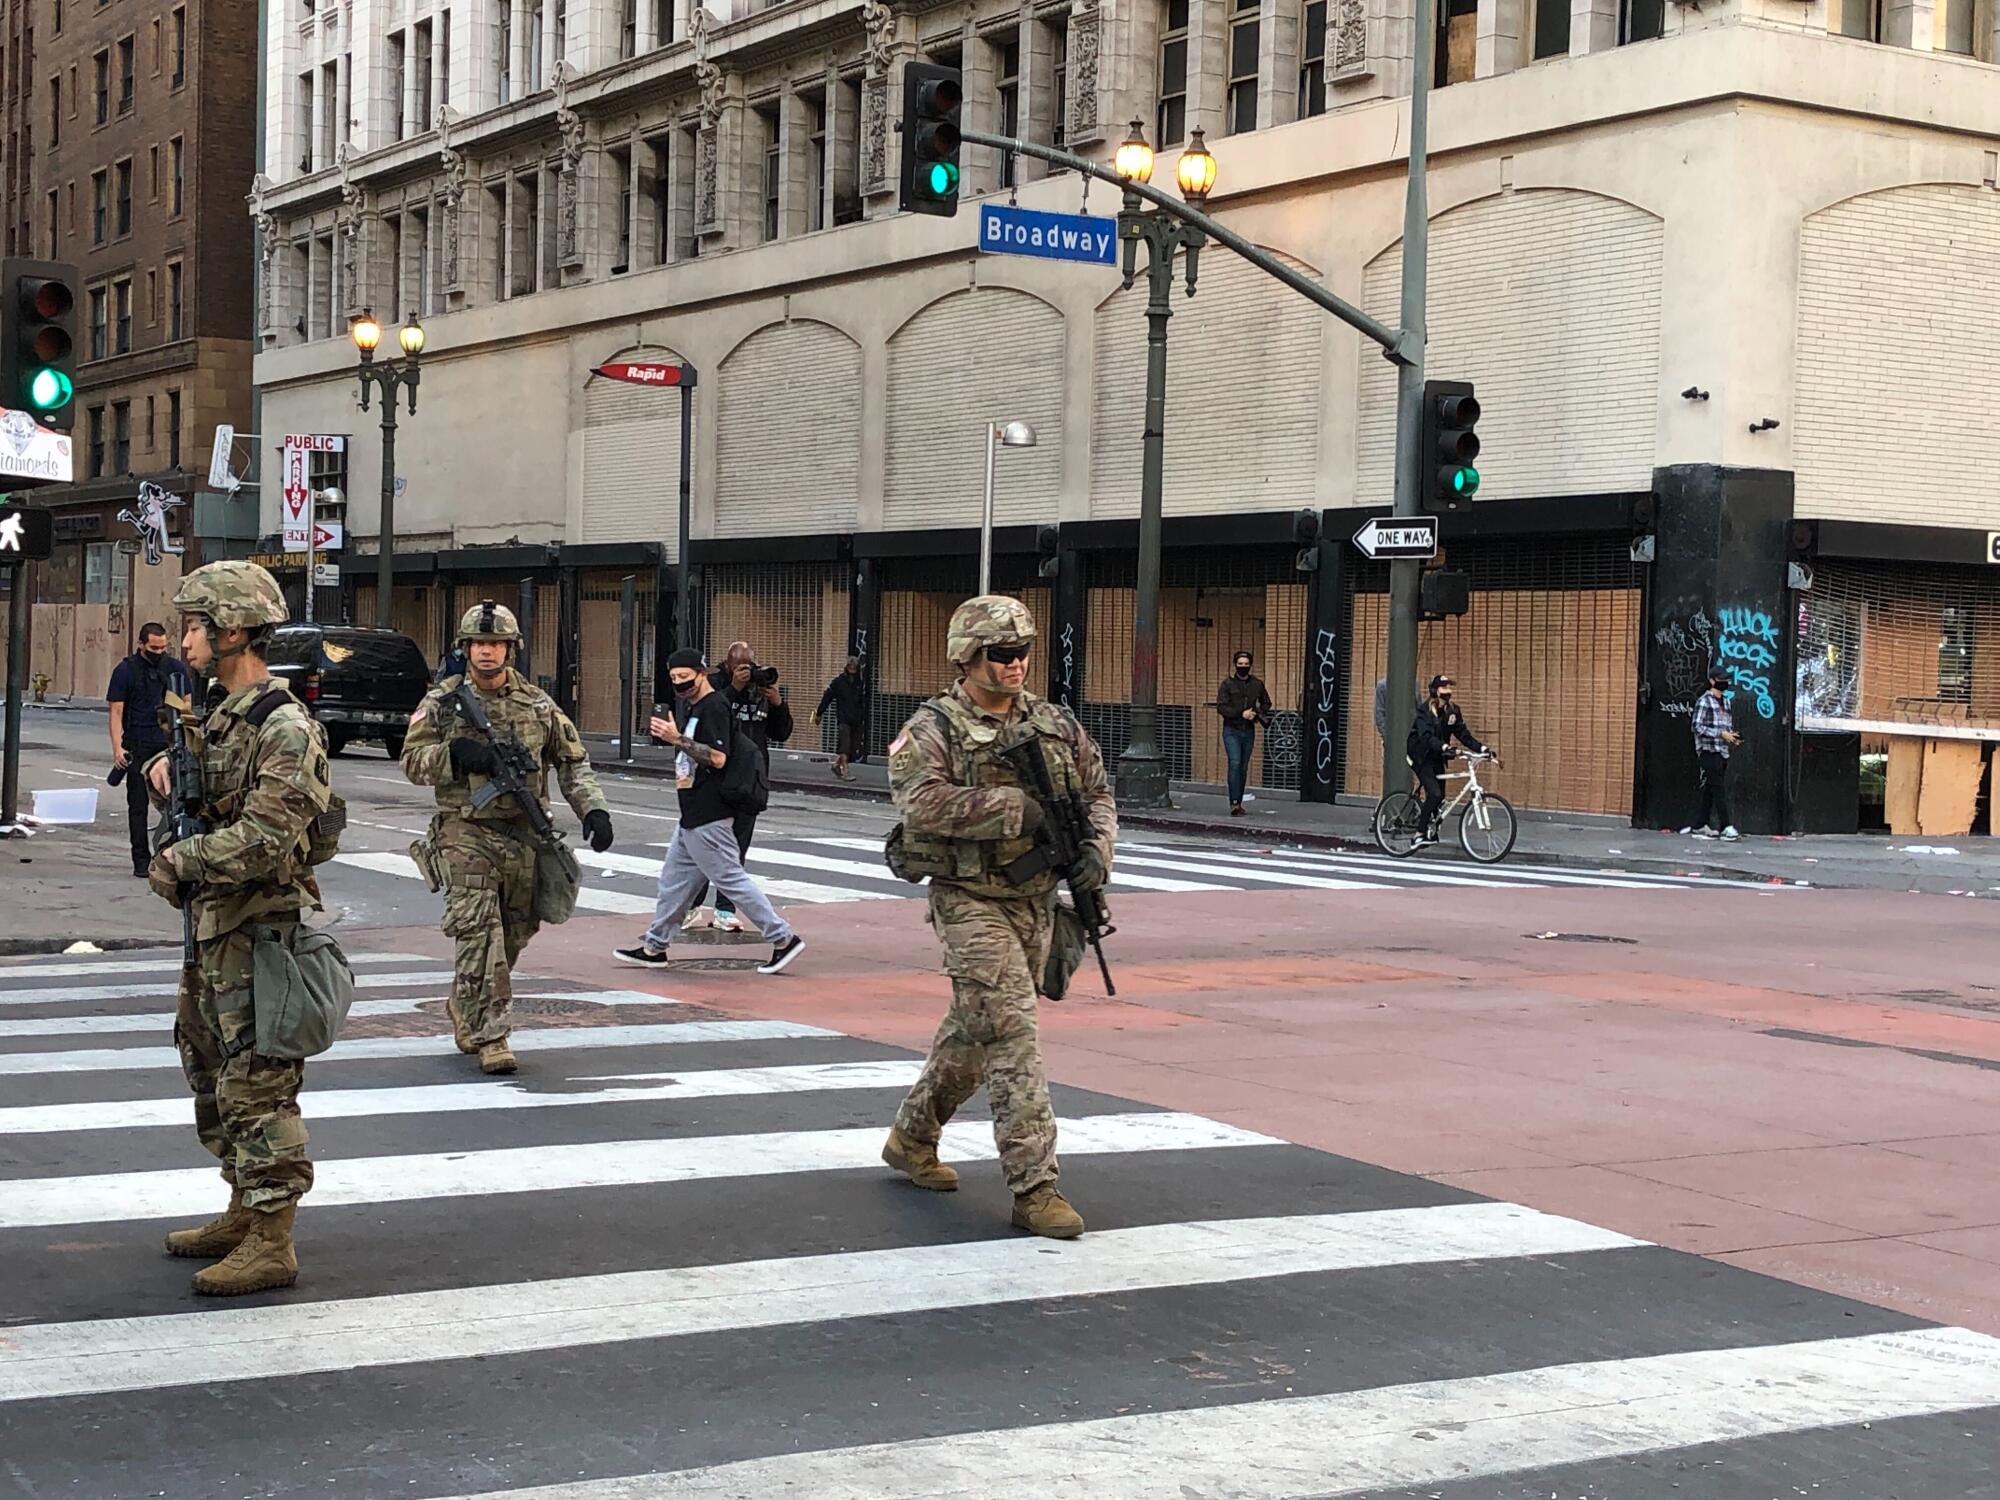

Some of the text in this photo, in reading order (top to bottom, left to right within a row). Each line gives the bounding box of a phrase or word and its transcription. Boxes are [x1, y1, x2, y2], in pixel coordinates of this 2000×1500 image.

[987, 216, 1109, 258] Broadway
[627, 366, 665, 381] Rapid
[285, 435, 333, 449] PUBLIC
[292, 451, 300, 508] PARKING
[1377, 530, 1426, 545] ONE WAY
